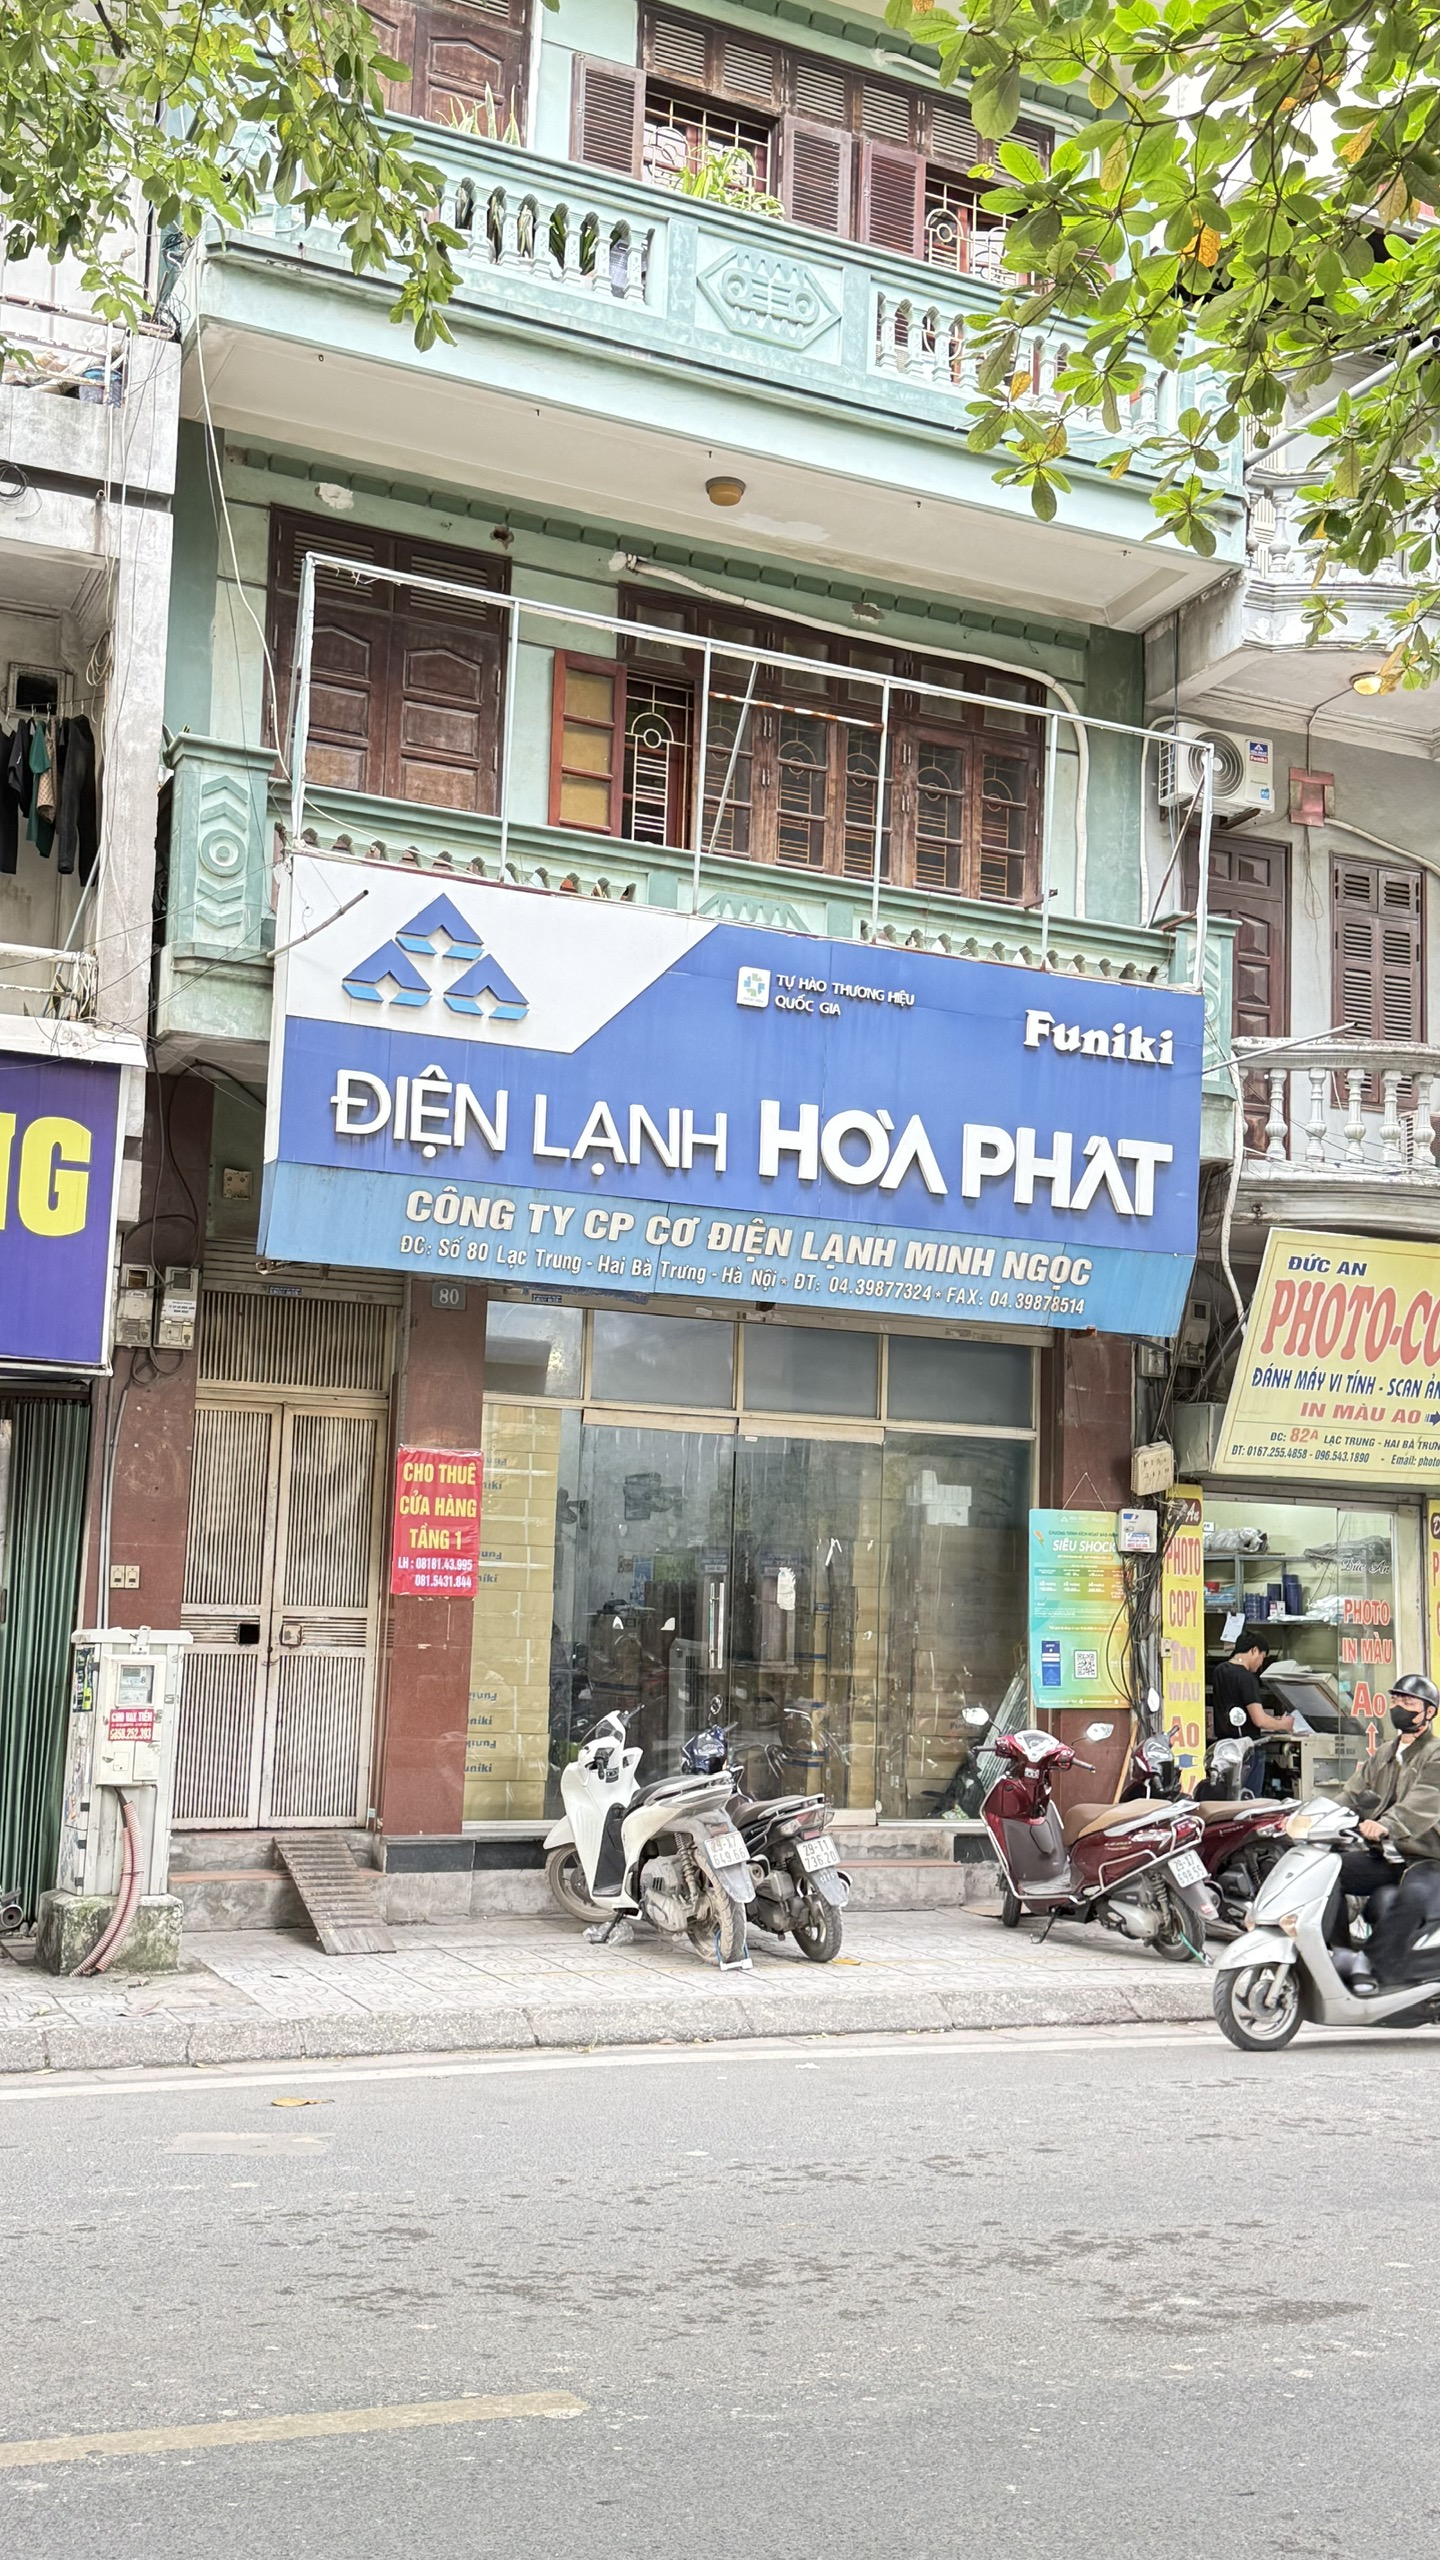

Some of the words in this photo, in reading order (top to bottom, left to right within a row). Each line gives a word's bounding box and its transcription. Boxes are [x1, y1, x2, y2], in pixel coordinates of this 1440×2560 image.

[777, 974, 795, 990] TỰ
[798, 976, 827, 992] HÀO
[832, 982, 885, 1001] THƯƠNG
[887, 990, 915, 1006] HIỆU
[774, 994, 814, 1012] QUỐC
[819, 1003, 841, 1015] GIA
[1023, 1009, 1175, 1065] Funiki
[330, 1064, 509, 1159] ĐIỆN
[532, 1093, 728, 1176] LẠNH
[0, 1113, 92, 1237] G
[405, 1186, 515, 1231] CÔNG
[528, 1203, 576, 1236] TY
[583, 1208, 635, 1242] CP
[646, 1215, 701, 1247] CƠ
[707, 1218, 793, 1264] ĐIỆN
[801, 1230, 896, 1271] LẠNH
[904, 1241, 998, 1278] MINH
[1002, 1250, 1094, 1290] NGỌC
[400, 1235, 432, 1255] ĐC:
[438, 1238, 461, 1258] Số
[466, 1243, 489, 1261] 80
[496, 1245, 527, 1270] Lạc
[535, 1248, 582, 1275] Trung
[598, 1254, 625, 1275] Hai
[631, 1256, 652, 1277] Bà
[660, 1260, 706, 1284] Trưng
[721, 1266, 743, 1284] Hà
[750, 1269, 777, 1296] Nội
[793, 1274, 822, 1292] ĐT:
[828, 1276, 932, 1301] 04.39877324
[946, 1286, 983, 1306] FAX:
[989, 1290, 1085, 1315] 04.39878514
[1287, 1253, 1331, 1273] ĐỨC
[1336, 1262, 1368, 1276] AN
[439, 1288, 460, 1305] 80
[1251, 1363, 1293, 1389] ĐÁNH
[1294, 1365, 1325, 1391] MÁY
[1329, 1373, 1342, 1392] VI
[1346, 1369, 1377, 1395] TÍNH
[1386, 1377, 1422, 1399] SCAN
[1300, 1402, 1326, 1418] IN
[1332, 1403, 1386, 1422] MÀU
[1289, 1427, 1318, 1443] 82A
[1323, 1435, 1342, 1446] LẠC
[1345, 1437, 1375, 1447] TRUNG
[1384, 1438, 1400, 1449] HAI
[1402, 1438, 1415, 1450] BÀ
[1315, 1449, 1370, 1463] 096.543.1890
[1391, 1454, 1417, 1466] Email:
[403, 1462, 434, 1482] CHO
[438, 1462, 476, 1485] THUÊ
[400, 1490, 430, 1516] CỬA
[434, 1494, 477, 1518] HÀNG
[409, 1523, 450, 1550] TẦNG
[455, 1531, 462, 1550] 1
[1052, 1538, 1077, 1552] SIÊU
[1080, 1540, 1117, 1553] SHOCK
[398, 1556, 409, 1569] LH
[416, 1557, 473, 1571] 08181.43.995
[1166, 1537, 1201, 1576] PHOTO
[414, 1574, 472, 1588] 081.5431.844
[1169, 1589, 1198, 1628] COPY
[1343, 1599, 1391, 1627] PHOTO
[1342, 1637, 1358, 1664] IN
[1360, 1632, 1394, 1665] MÀU
[711, 1835, 737, 1852] 29-X7
[803, 1840, 829, 1856] 29-T1
[805, 1851, 837, 1869] 736.20
